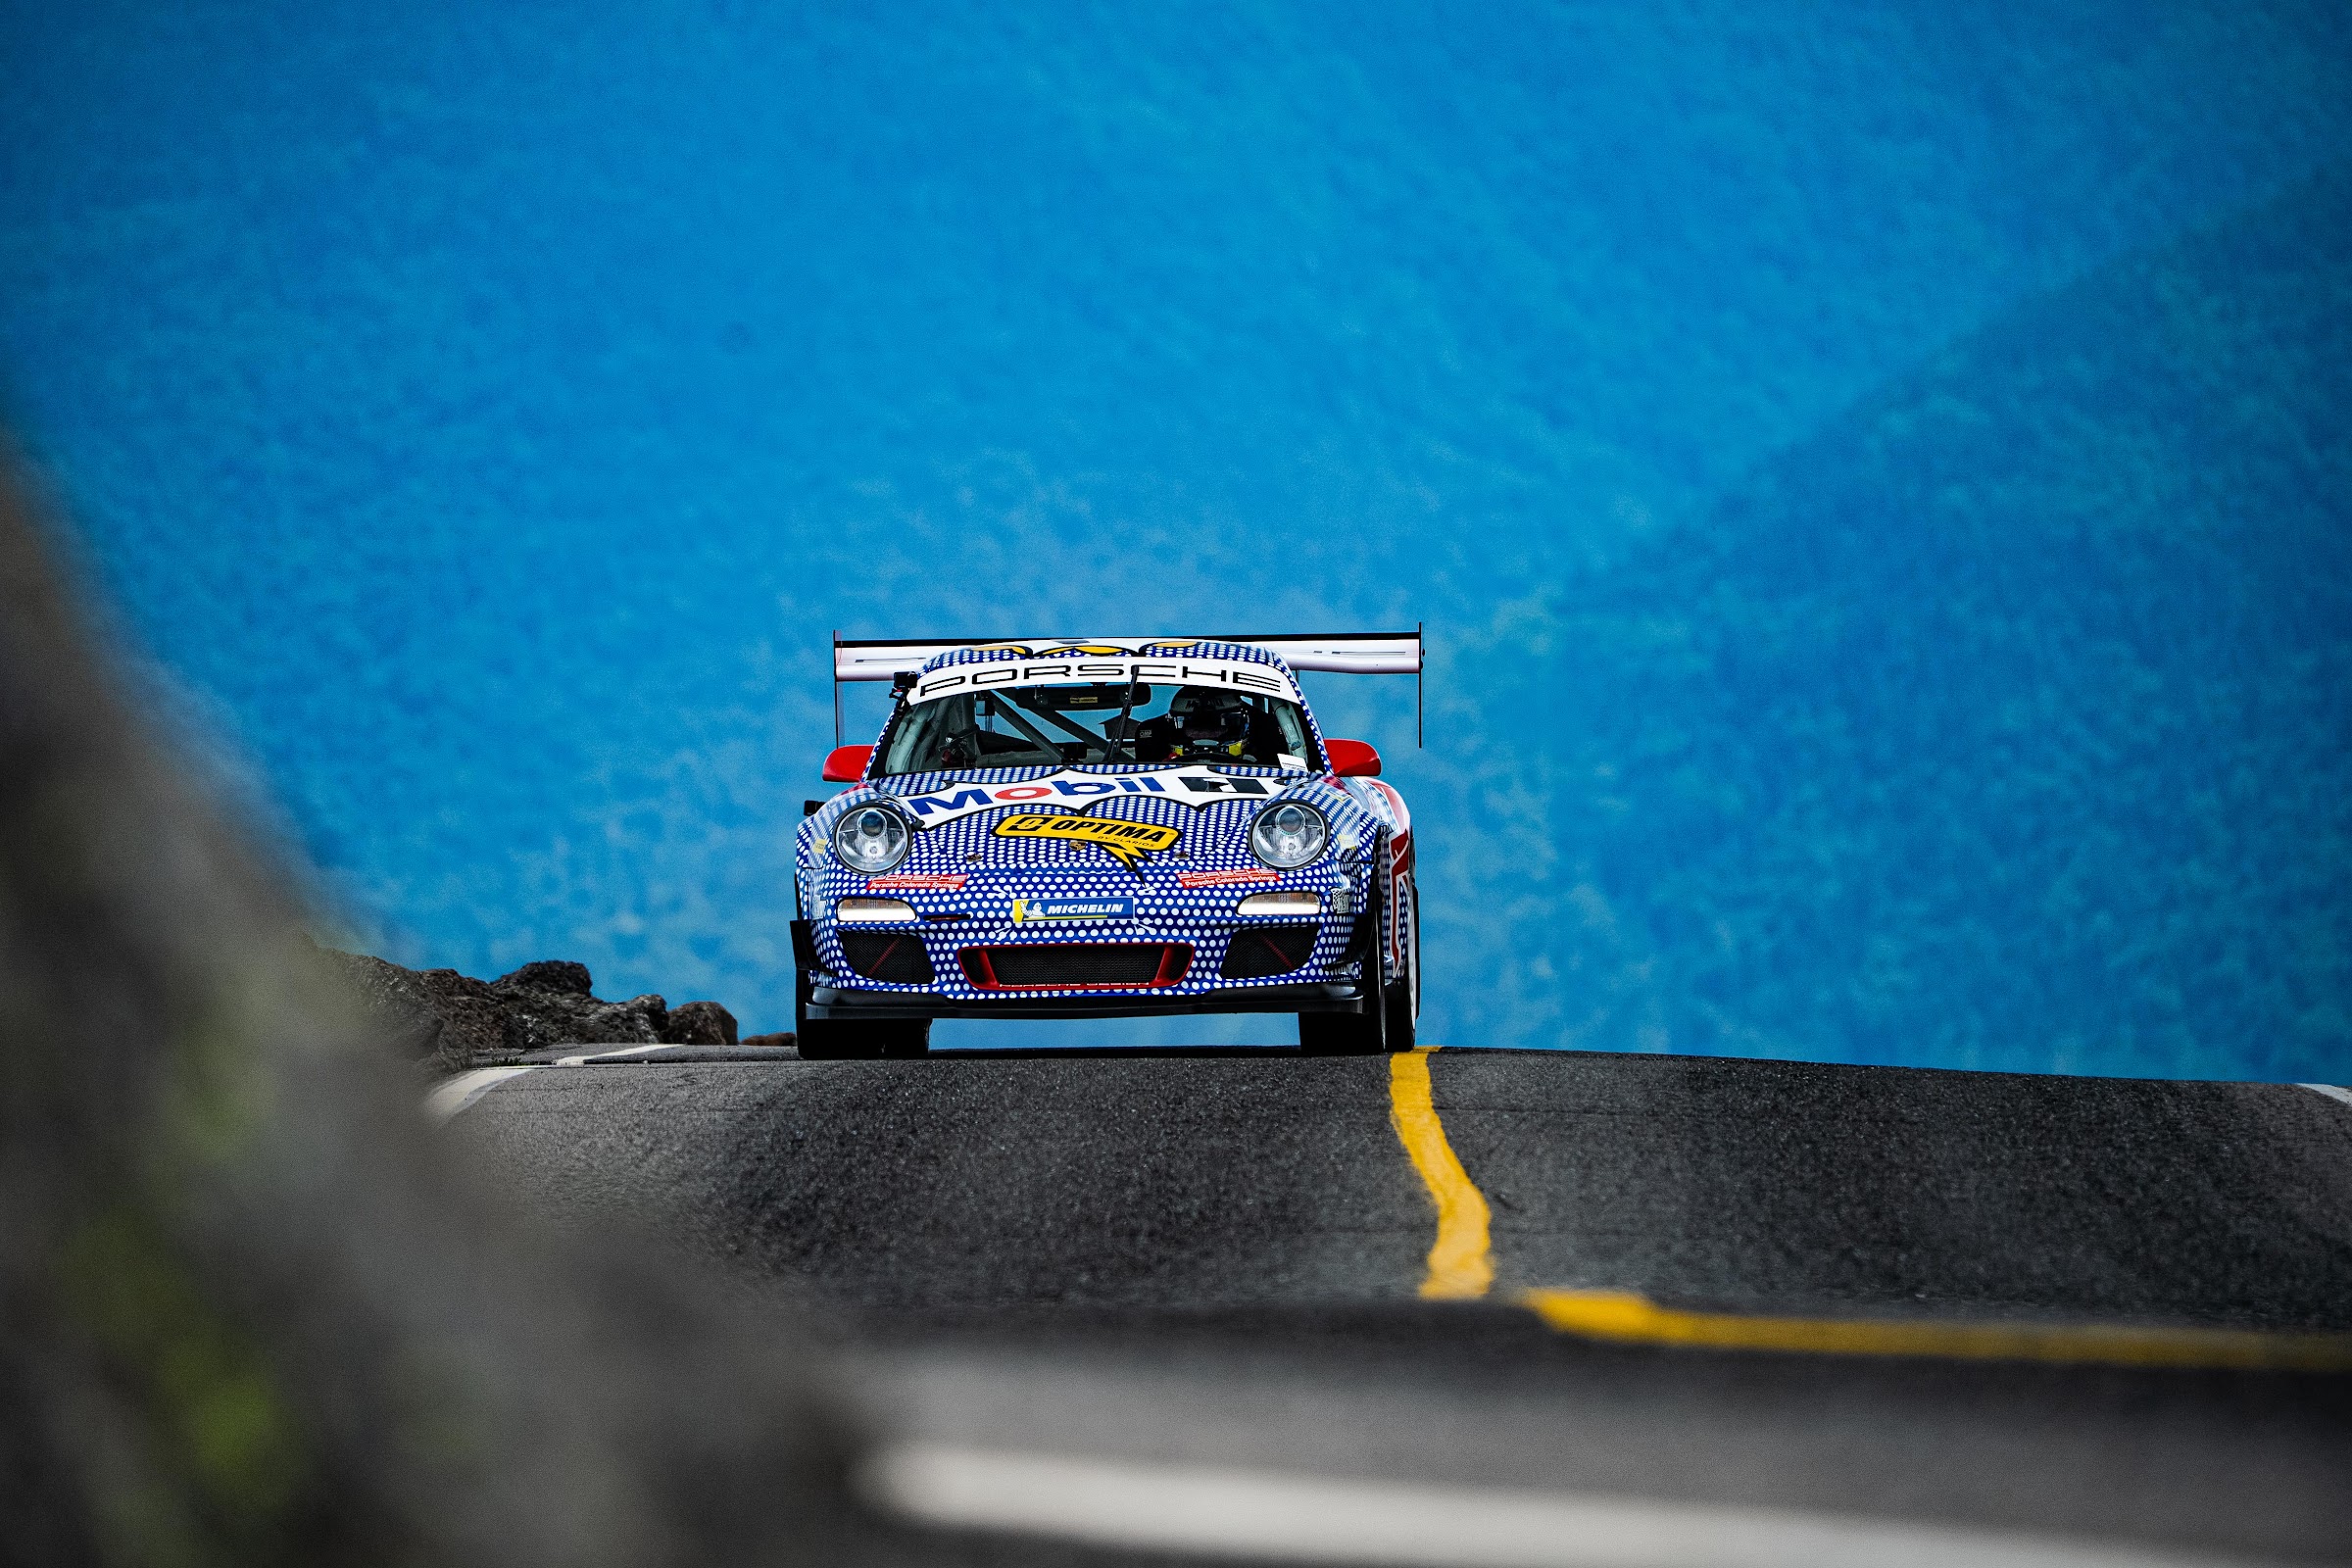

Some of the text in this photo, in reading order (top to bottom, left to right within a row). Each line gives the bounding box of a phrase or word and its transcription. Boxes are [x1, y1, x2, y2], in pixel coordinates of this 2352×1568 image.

[919, 663, 1281, 697] PORSCHE
[911, 776, 1166, 816] Mobil
[1050, 819, 1167, 843] OPTIMA
[1177, 869, 1277, 880] PORSCHE
[1047, 904, 1124, 914] MICHELIN
